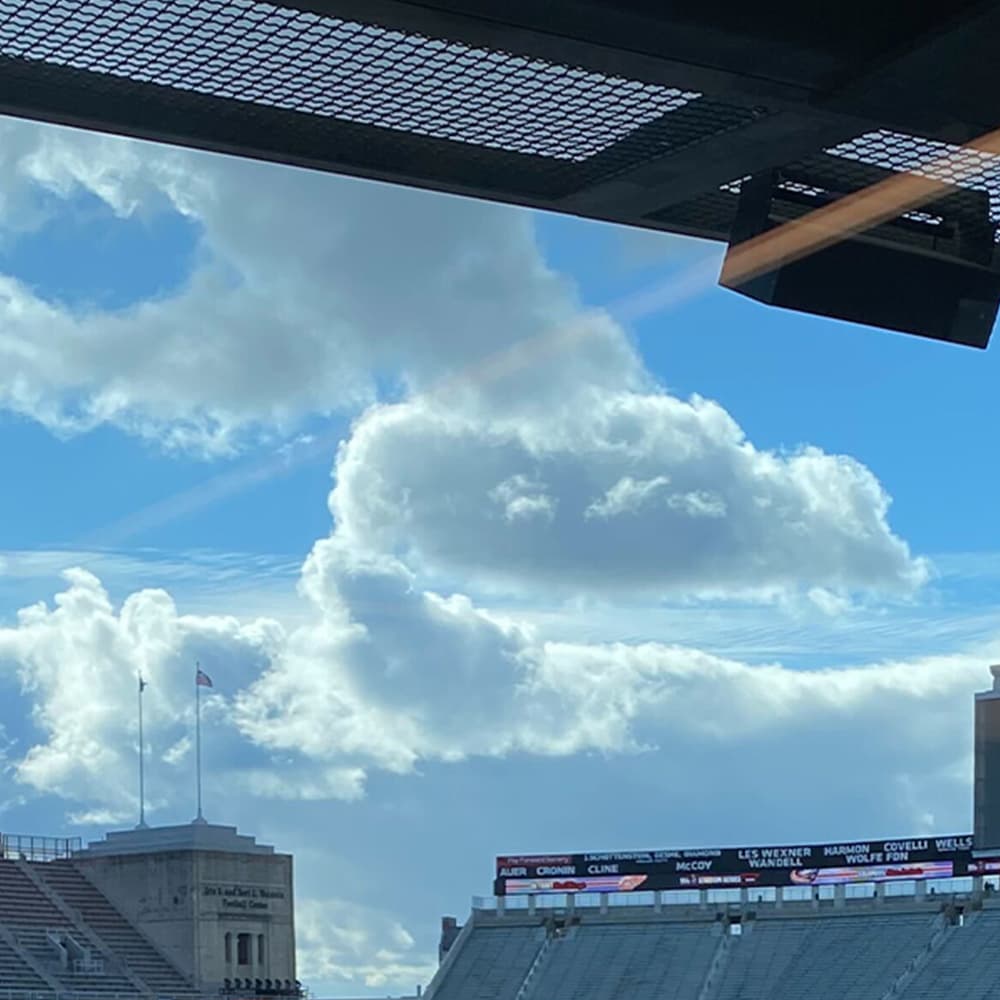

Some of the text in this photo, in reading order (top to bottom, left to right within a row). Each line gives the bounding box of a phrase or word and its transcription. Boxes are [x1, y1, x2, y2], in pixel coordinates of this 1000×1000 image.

[884, 840, 928, 853] COVELLI
[935, 837, 973, 849] WELLS
[738, 847, 812, 860] LES WEXNER
[824, 844, 871, 857] HARMON
[749, 858, 803, 869] WANDELL
[845, 854, 883, 864] WOLFE
[536, 866, 576, 877] CRONIN
[588, 864, 620, 875] CLINE
[676, 861, 713, 872] McCOY
